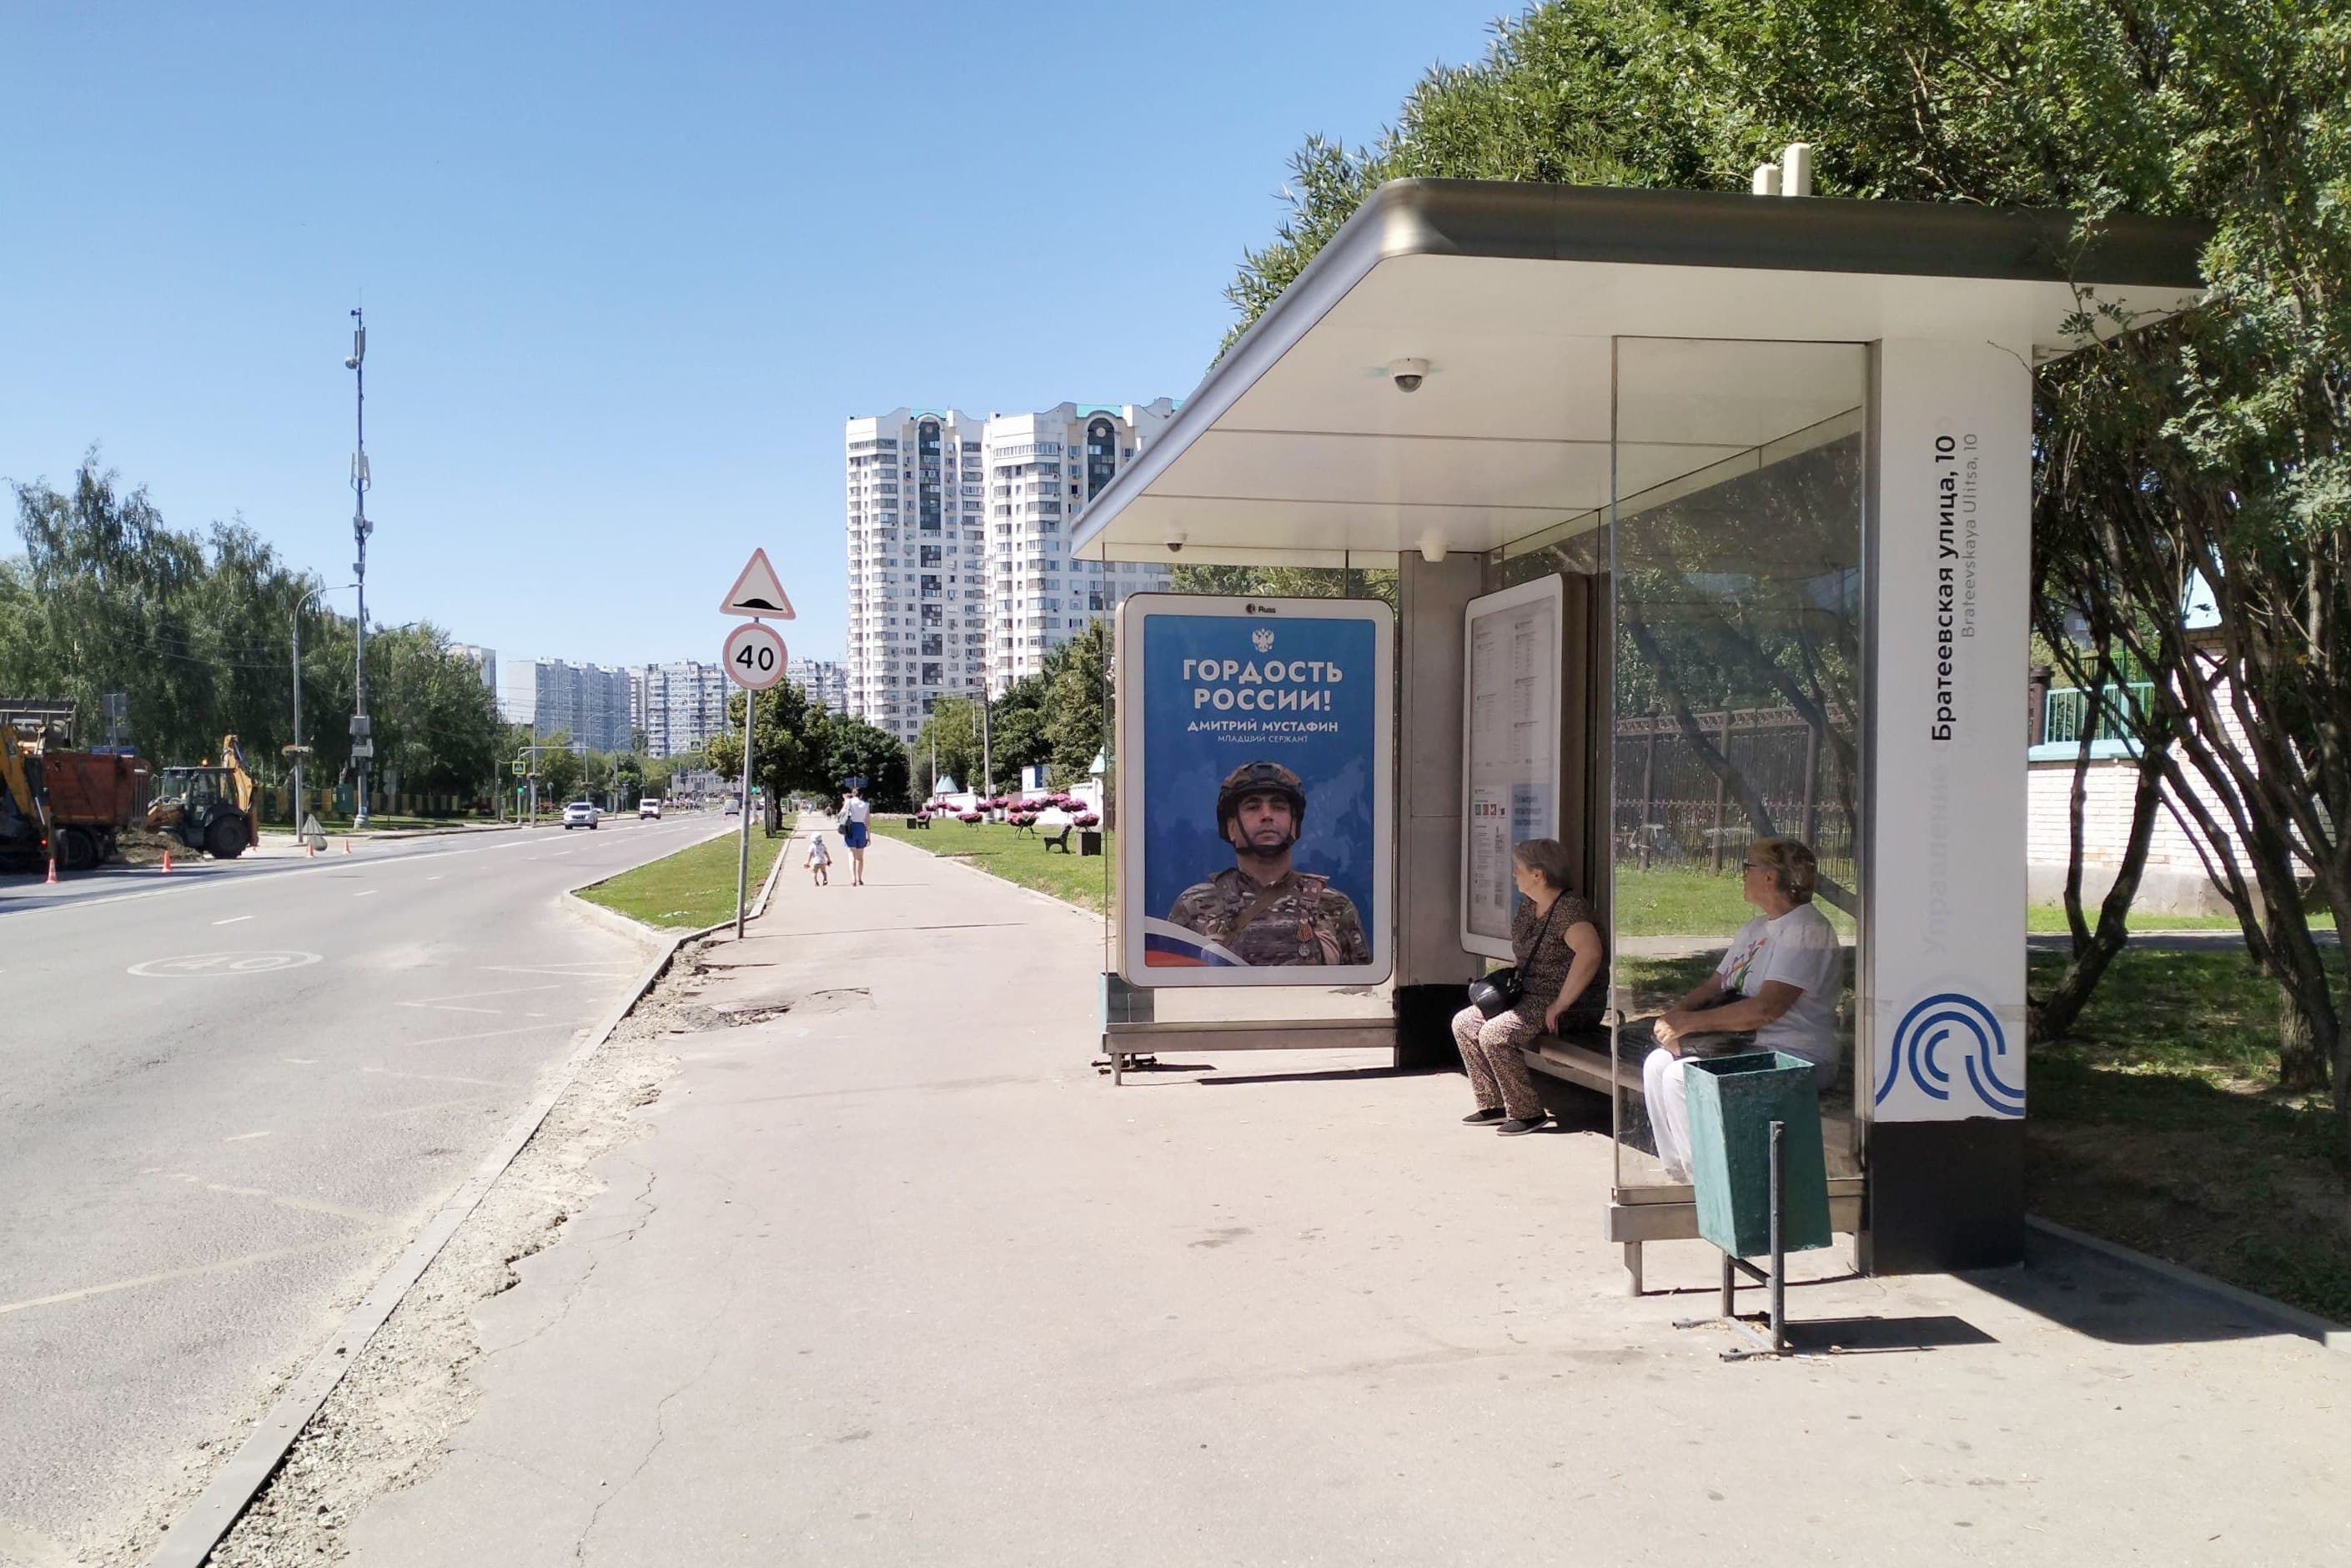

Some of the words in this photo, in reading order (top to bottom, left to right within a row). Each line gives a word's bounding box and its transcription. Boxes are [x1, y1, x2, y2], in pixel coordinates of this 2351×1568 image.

[1935, 435, 1956, 464] 10
[1963, 433, 1978, 452] 10
[1962, 456, 1980, 514] Ulitsa,
[1939, 470, 1959, 560] улица,
[1961, 519, 1980, 639] Brateevskaya
[1258, 605, 1276, 614] Russ
[736, 645, 774, 671] 40
[1932, 567, 1957, 741] Братеевская
[1183, 659, 1343, 684] ГОРДОСТЬ
[1194, 688, 1331, 711] РОССИИ!
[1187, 718, 1257, 732] ДМИТРИЙ
[1262, 721, 1339, 732] МУСТАФИН
[1218, 734, 1266, 742] МЛАДШИЙ
[1268, 735, 1308, 743] СЕРЖАНТ
